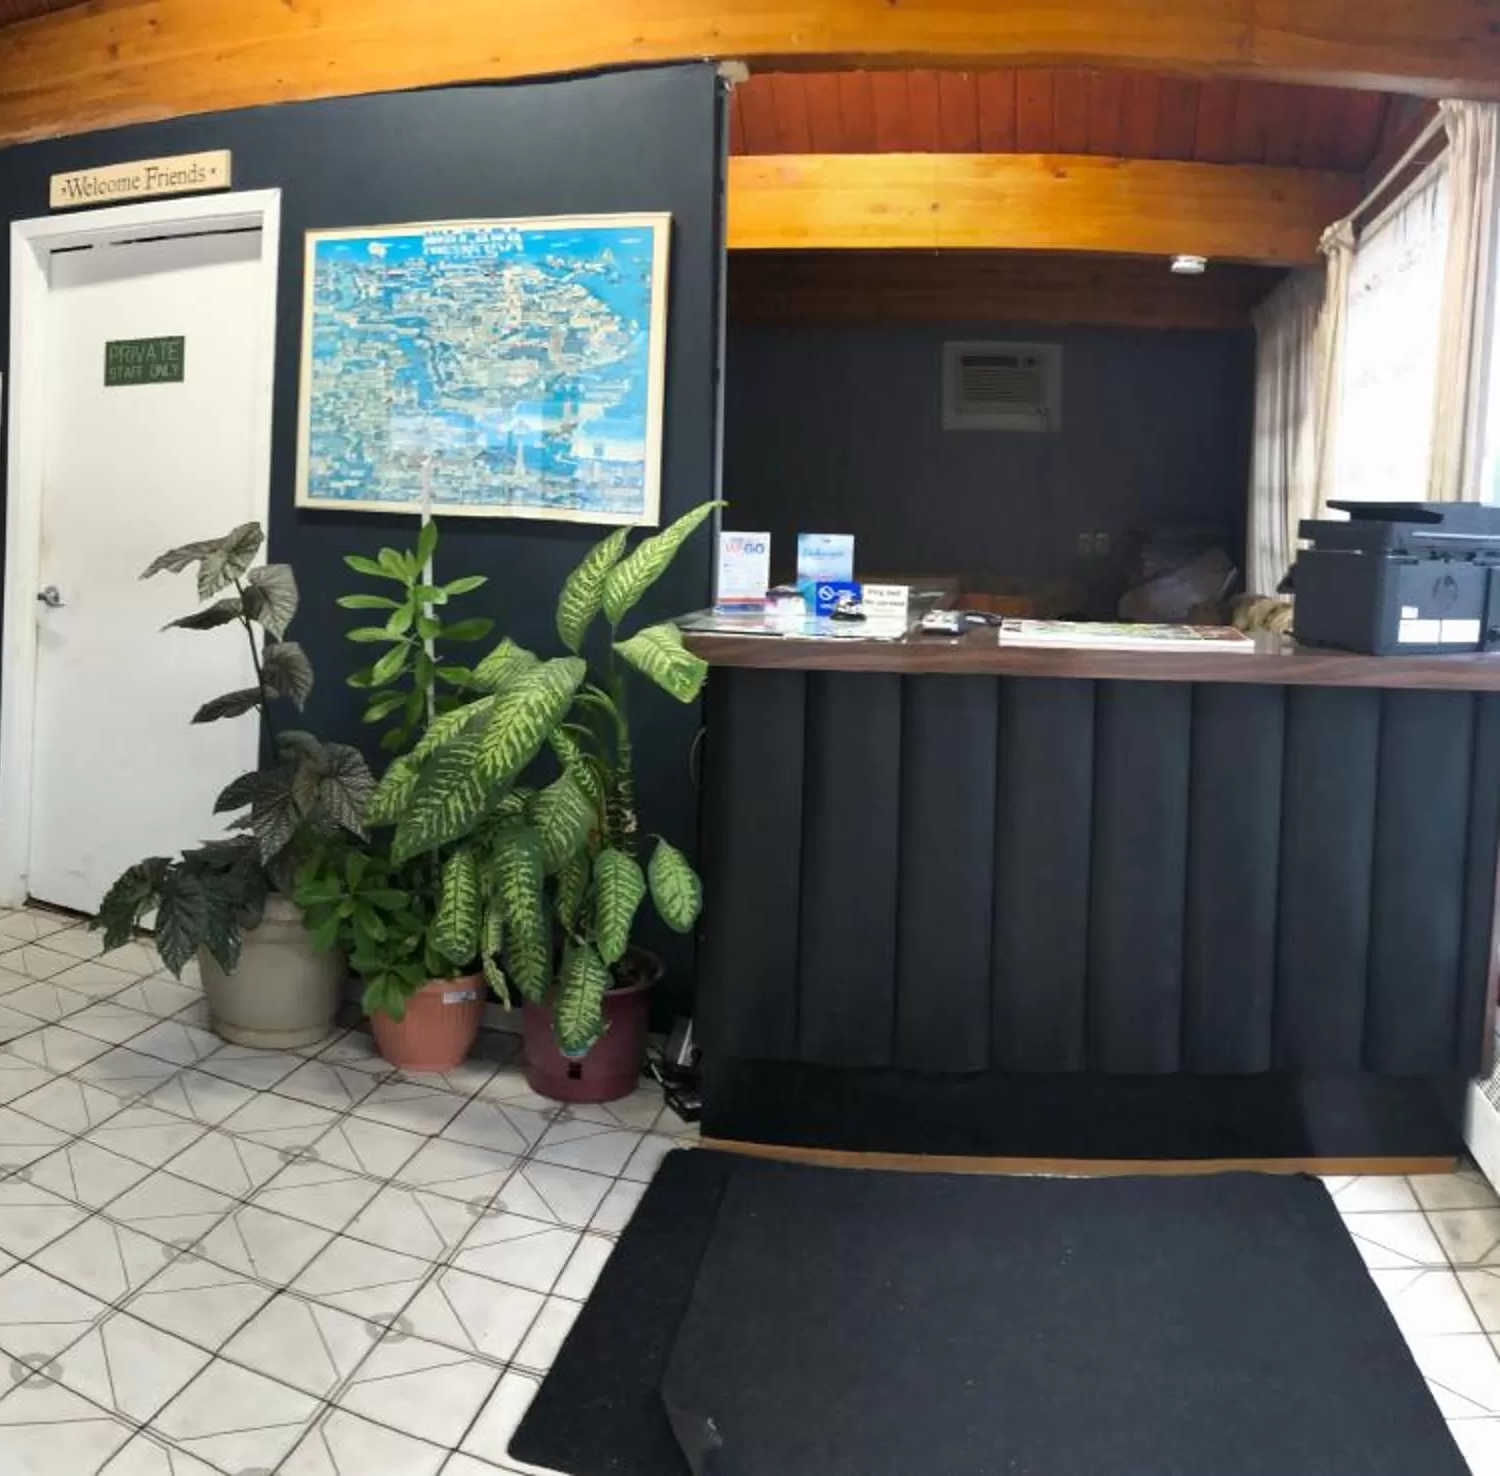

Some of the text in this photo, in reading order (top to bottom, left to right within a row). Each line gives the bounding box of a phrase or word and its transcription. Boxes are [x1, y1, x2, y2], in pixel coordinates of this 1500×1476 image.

[65, 163, 206, 198] Welcome Friends
[109, 341, 180, 365] PRIVATE
[109, 362, 179, 381] STAFF ONLY
